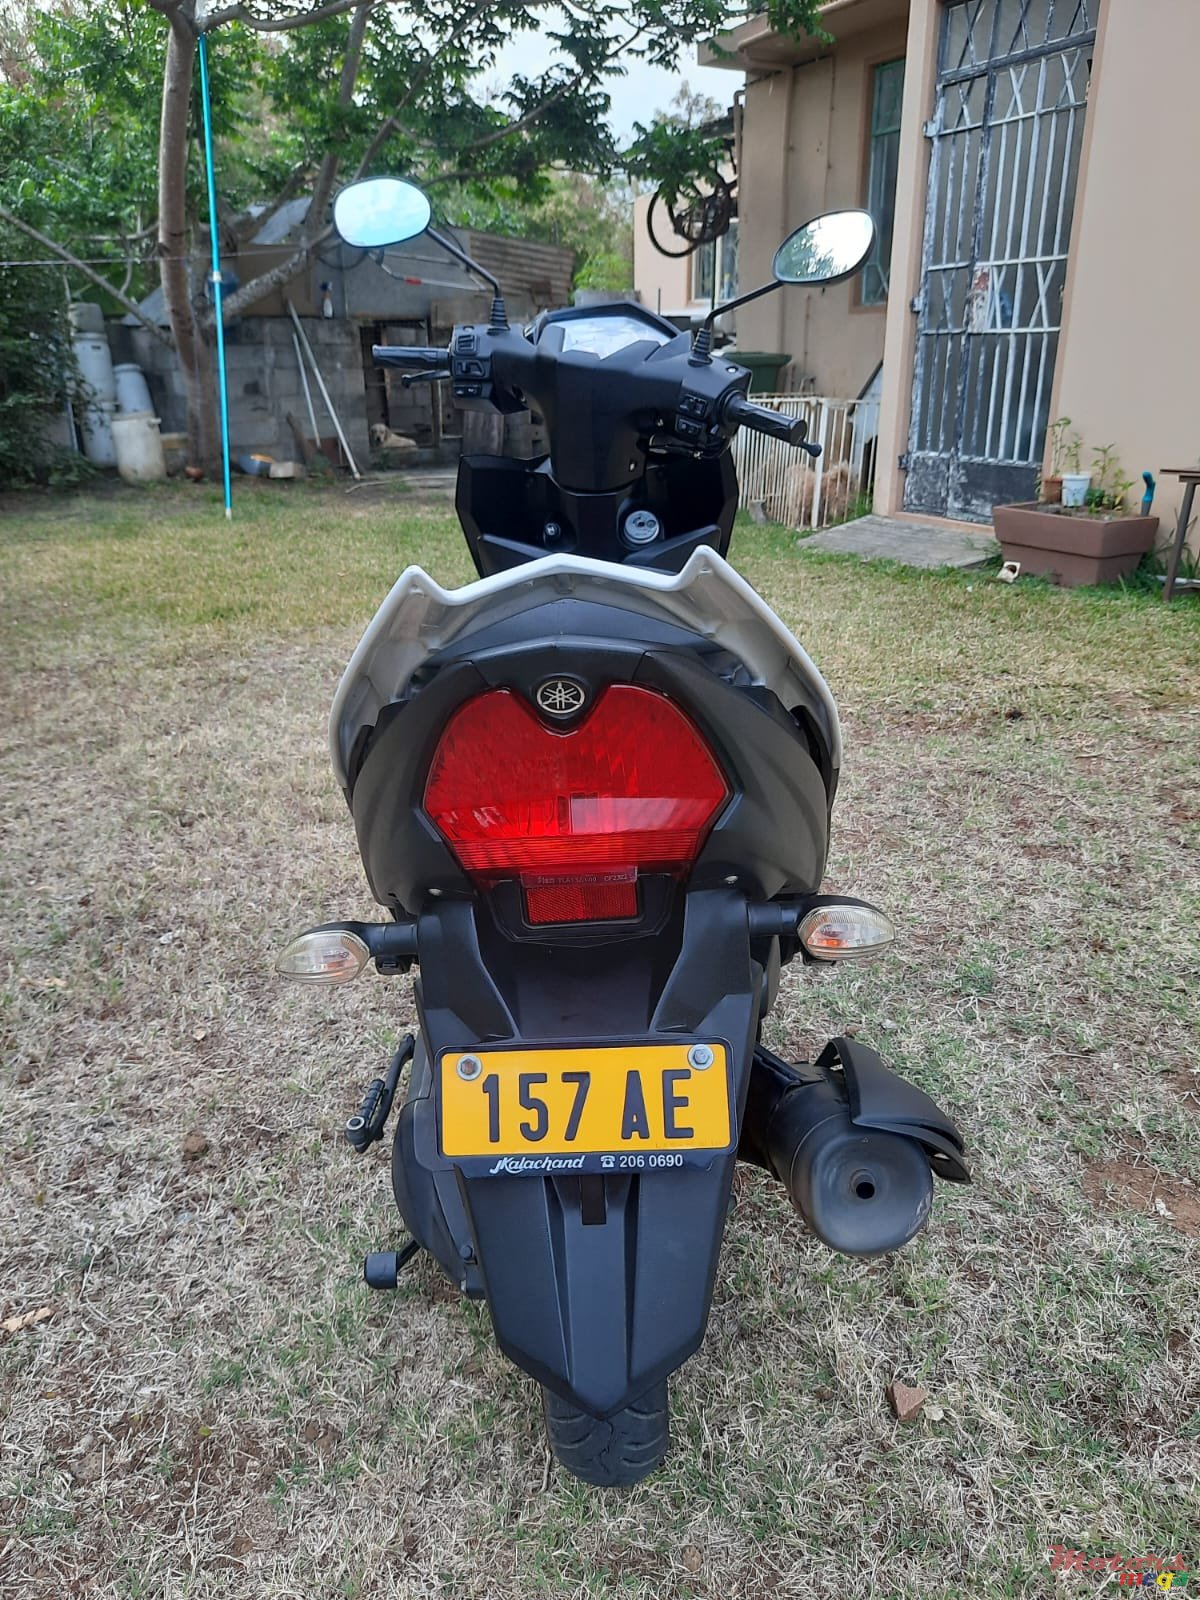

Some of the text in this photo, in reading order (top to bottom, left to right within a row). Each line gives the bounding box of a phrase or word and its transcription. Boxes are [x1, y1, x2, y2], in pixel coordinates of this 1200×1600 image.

[482, 1069, 695, 1143] 157 AE
[619, 1155, 645, 1168] 206
[649, 1154, 684, 1168] 0690
